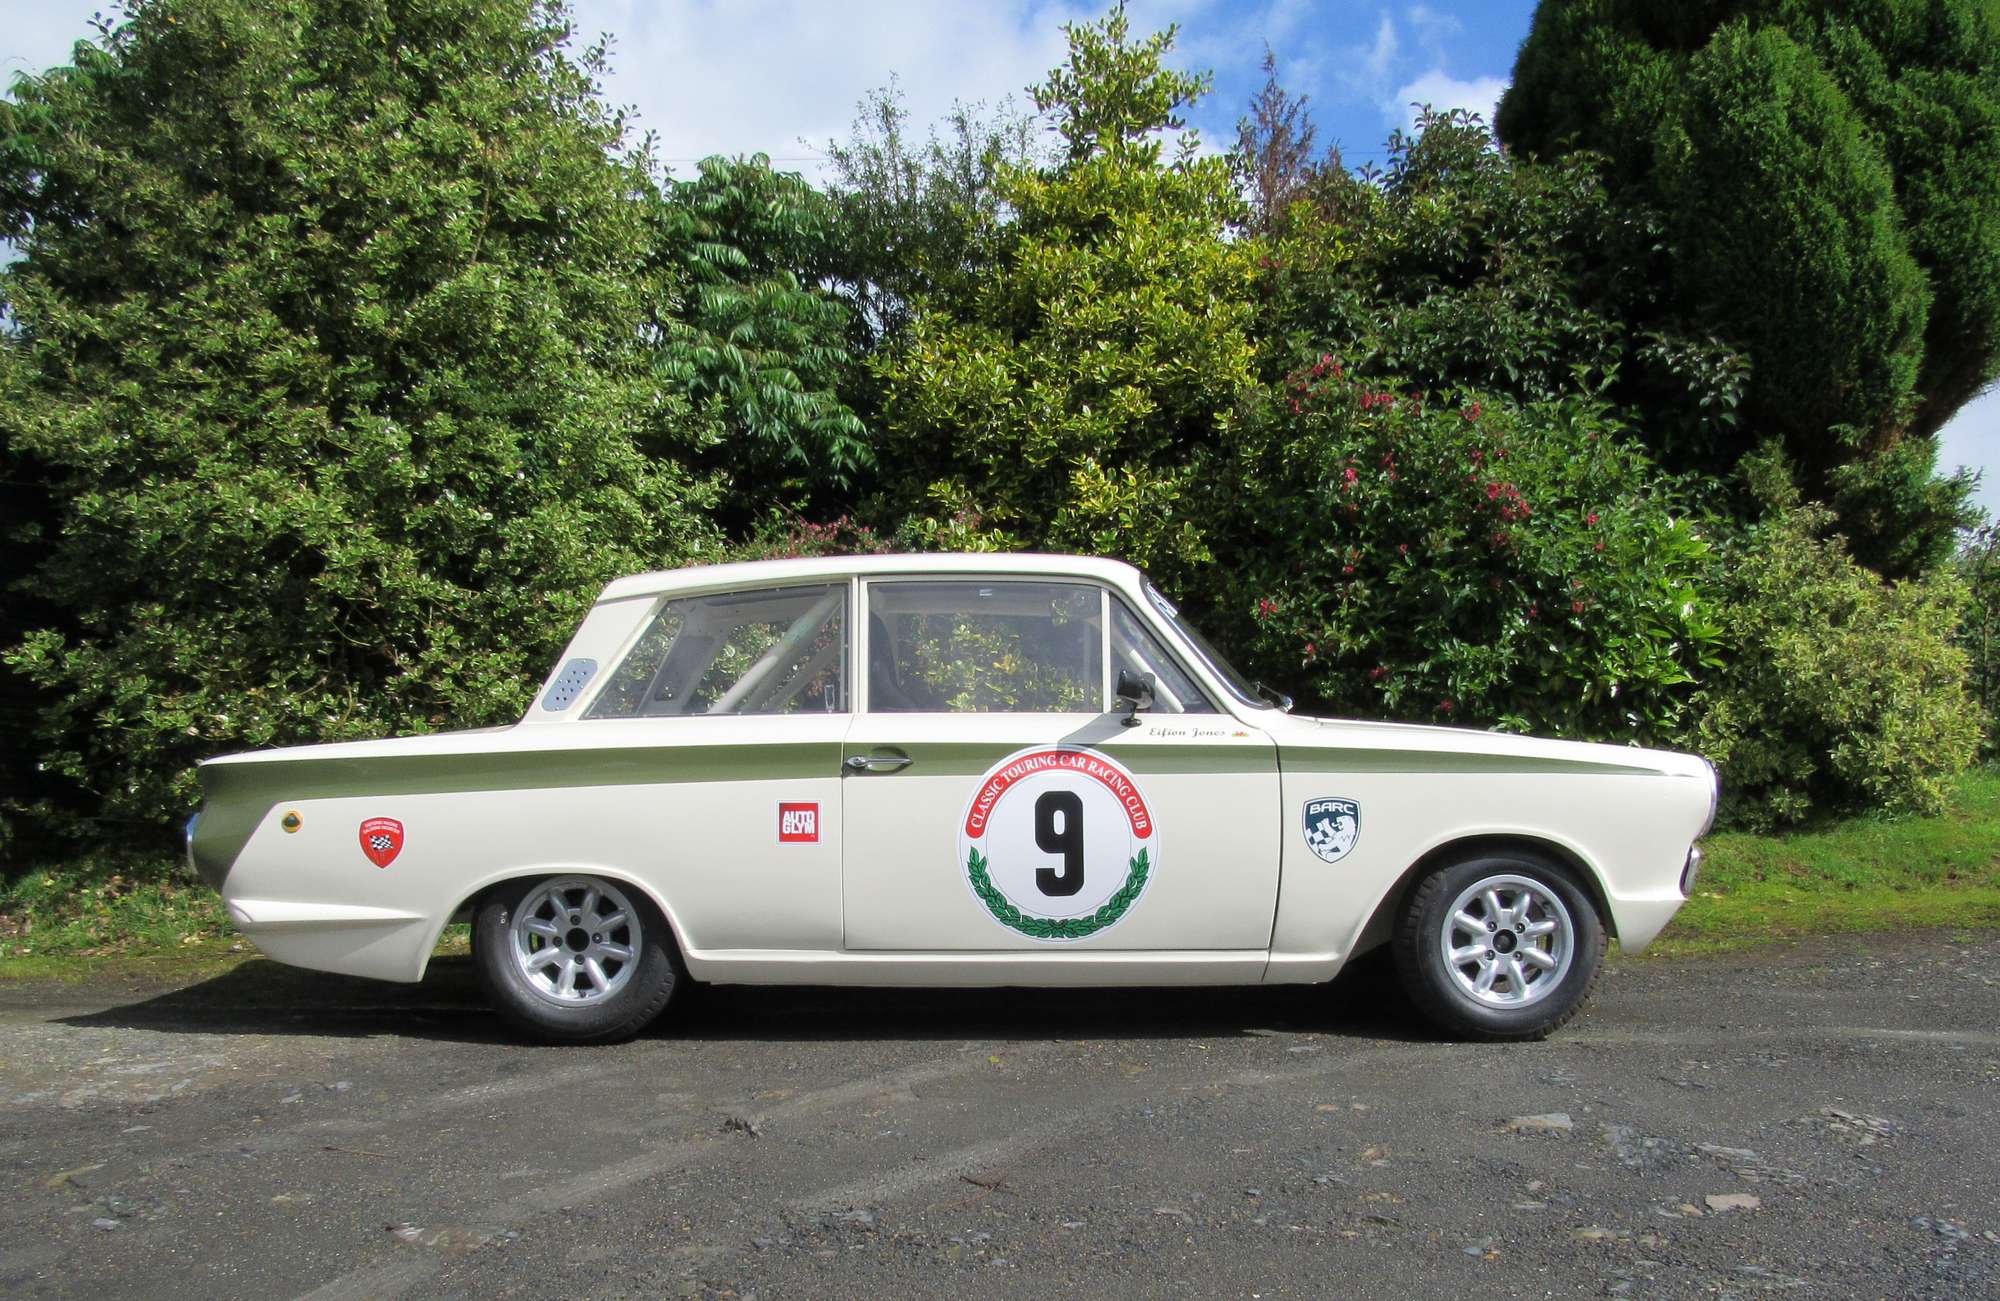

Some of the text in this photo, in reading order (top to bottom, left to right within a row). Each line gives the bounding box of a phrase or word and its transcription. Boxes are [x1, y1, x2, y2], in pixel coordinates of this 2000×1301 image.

[1192, 728, 1226, 738] Jones
[971, 754, 1148, 830] CLASSIC TOURING CAR RACING CLUB
[1309, 802, 1355, 815] BARC
[783, 810, 816, 823] AUTO
[782, 821, 816, 834] GLYM
[1034, 790, 1085, 897] 9
